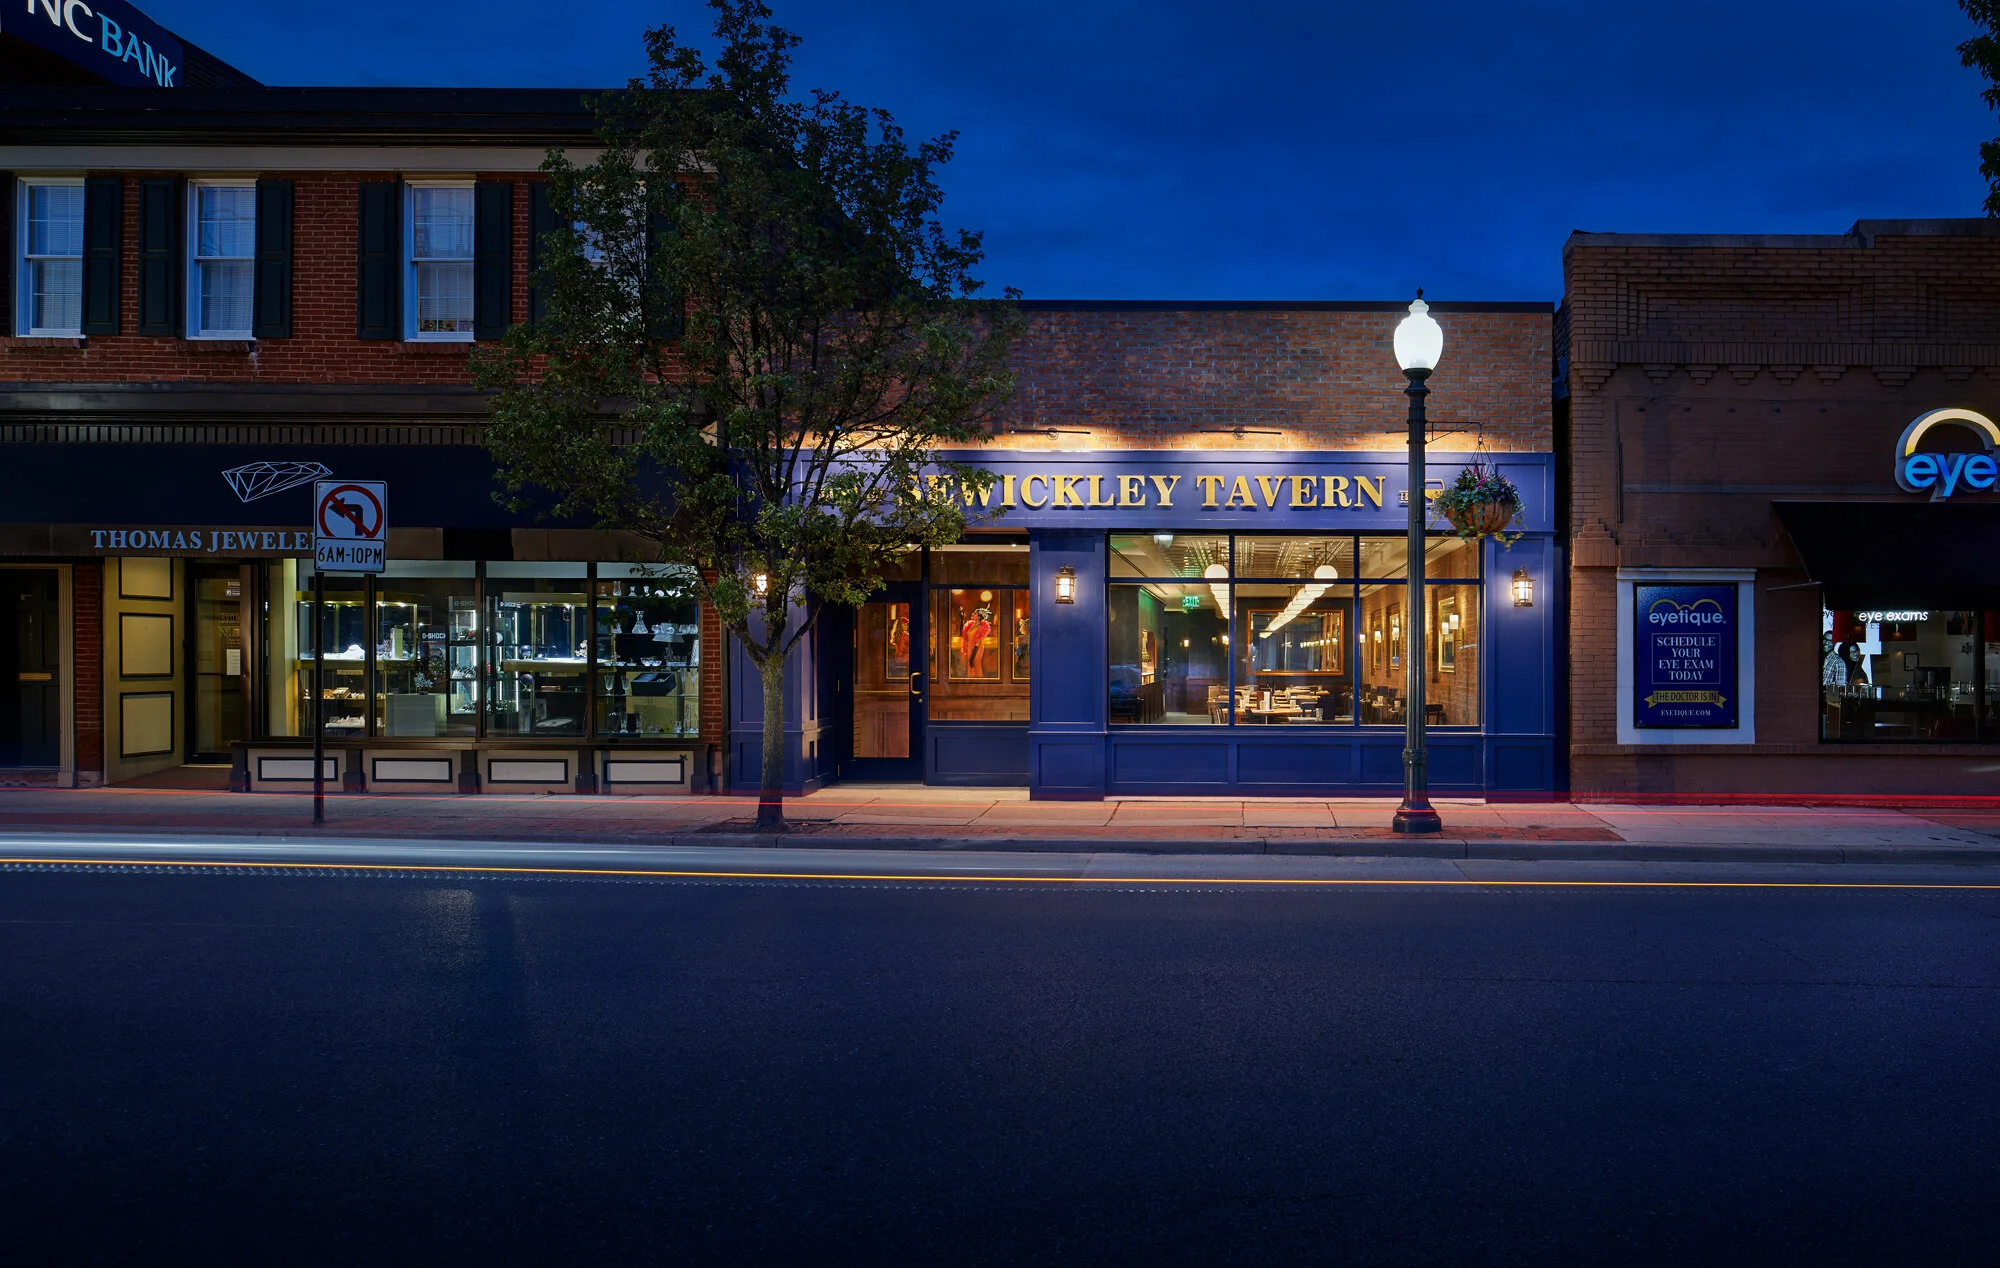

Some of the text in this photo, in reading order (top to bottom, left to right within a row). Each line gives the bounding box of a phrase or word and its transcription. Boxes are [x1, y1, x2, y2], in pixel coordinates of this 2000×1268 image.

[97, 12, 177, 88] BANK
[1196, 475, 1386, 507] TAVERN
[91, 530, 315, 552] THOMAS JEWELE
[317, 546, 383, 565] 6AM-10PM
[1649, 609, 1723, 626] eyetique
[1859, 610, 1929, 623] eye exams
[1657, 636, 1715, 646] SCHEDULE
[1672, 648, 1700, 657] YOUR
[1659, 659, 1713, 668] EYE EXAM
[1669, 670, 1703, 680] TODAY
[1656, 691, 1717, 701] THE DOCTOR IS IN
[1660, 709, 1711, 717] EYETIQUE.COM
